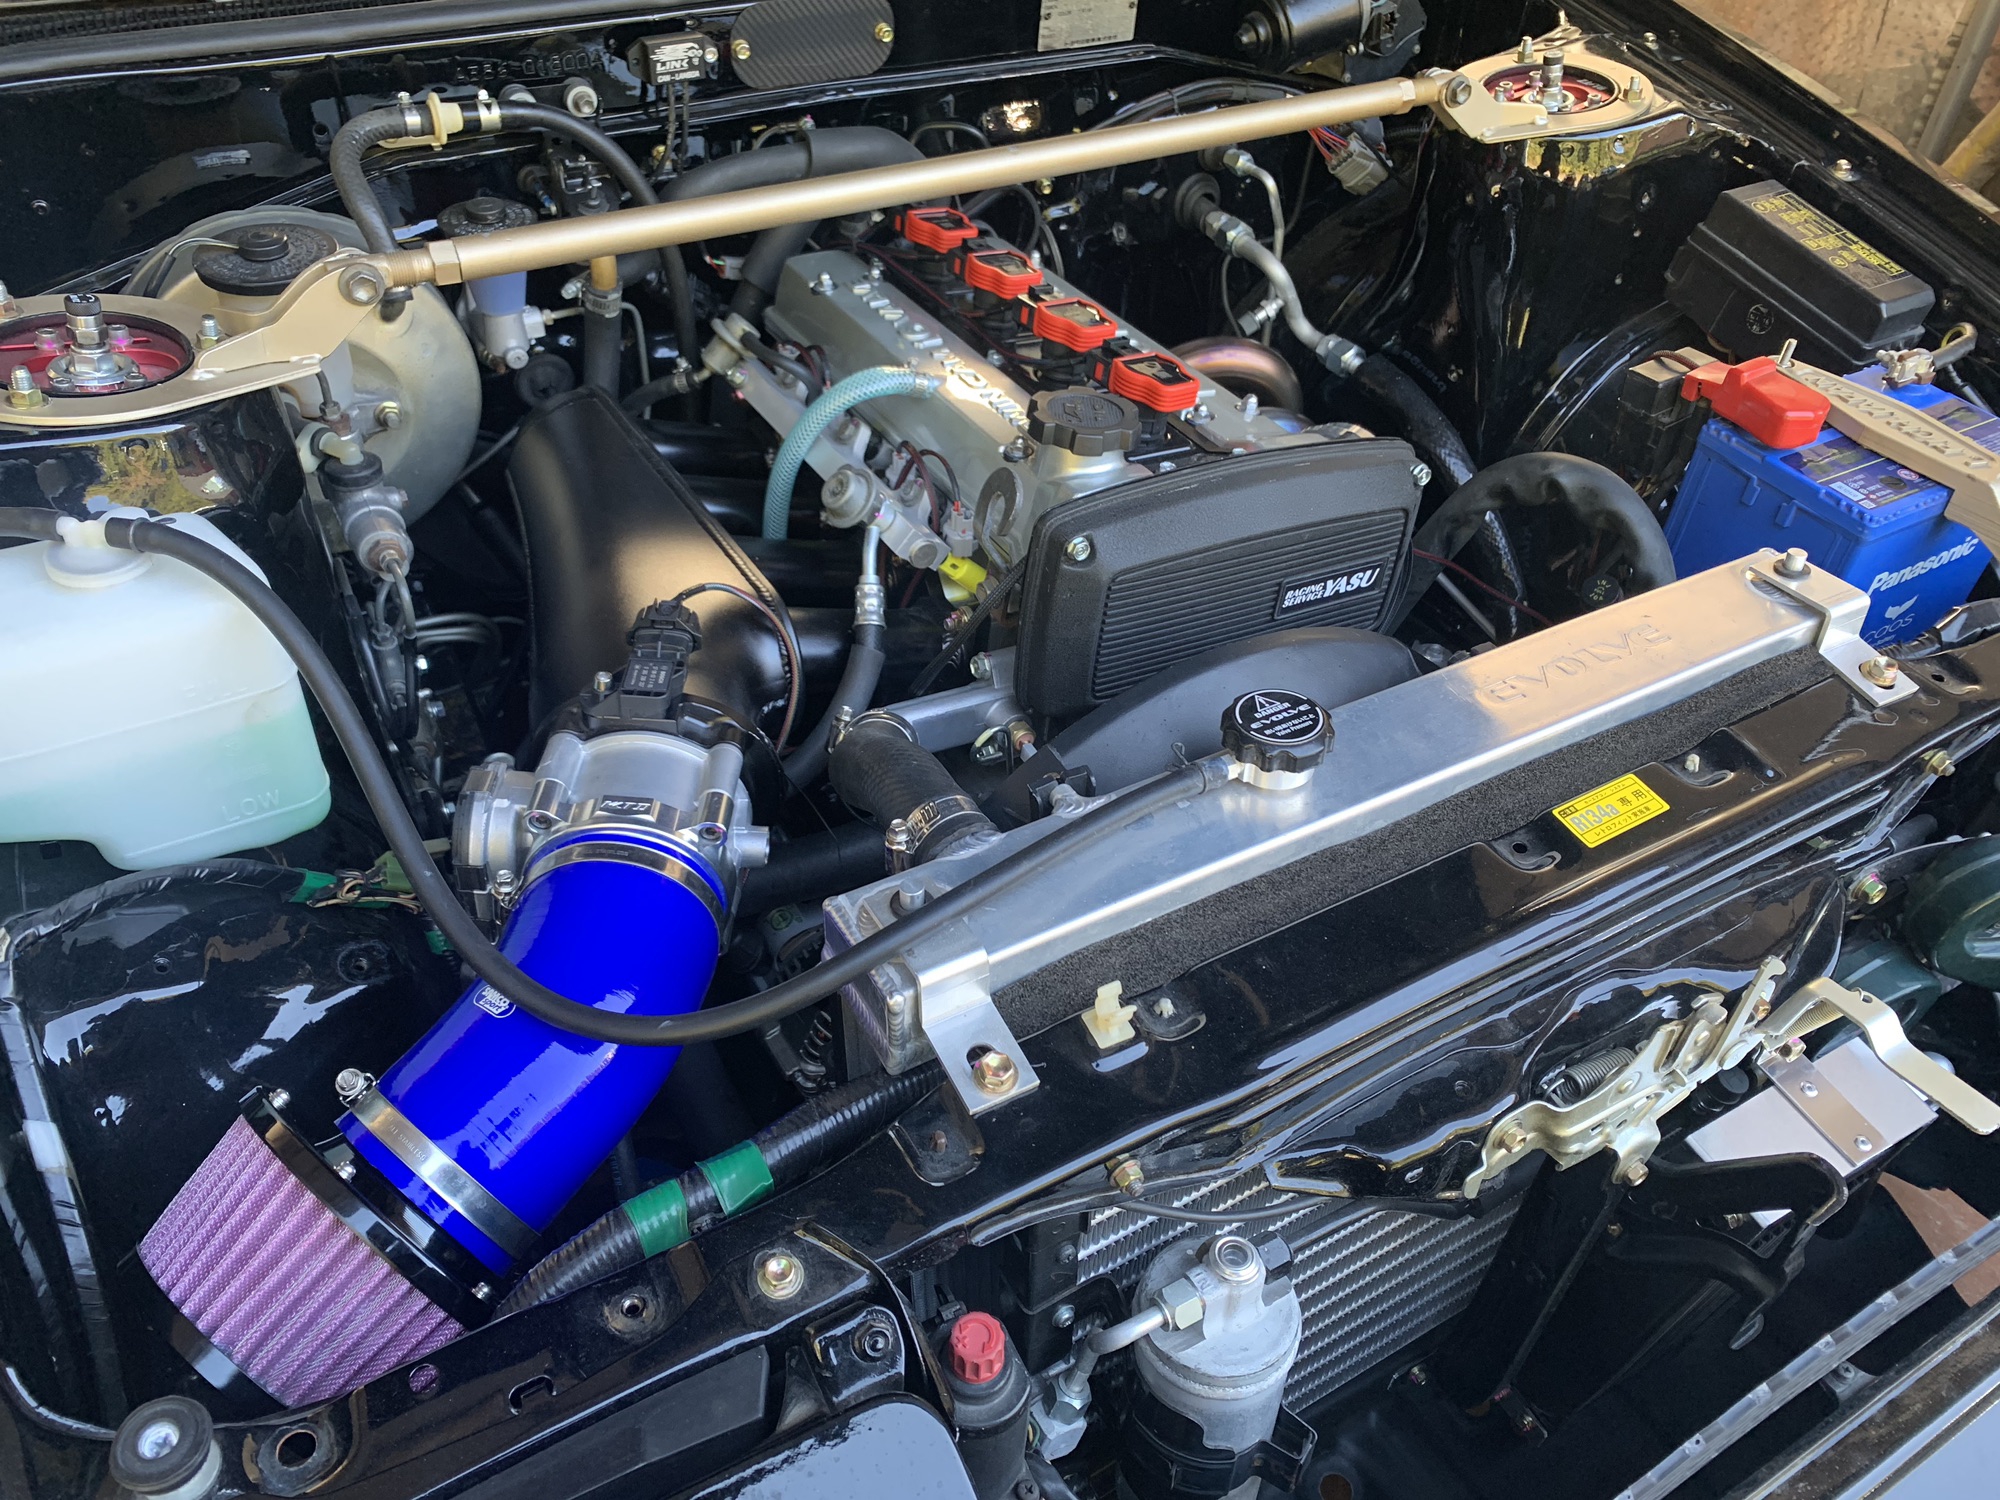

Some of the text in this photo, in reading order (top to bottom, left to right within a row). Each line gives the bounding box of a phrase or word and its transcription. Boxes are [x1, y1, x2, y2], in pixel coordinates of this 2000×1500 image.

[656, 58, 689, 71] LINK
[1867, 536, 1979, 597] Panasonic
[1285, 582, 1324, 600] RACING
[1323, 567, 1380, 598] YASU
[1282, 589, 1325, 608] SERVICE
[1480, 623, 1672, 703] EVOLVE
[1250, 703, 1311, 729] EVOLVE
[1254, 702, 1291, 718] DANGER
[221, 788, 280, 821] LOW
[1569, 803, 1621, 832] R134a
